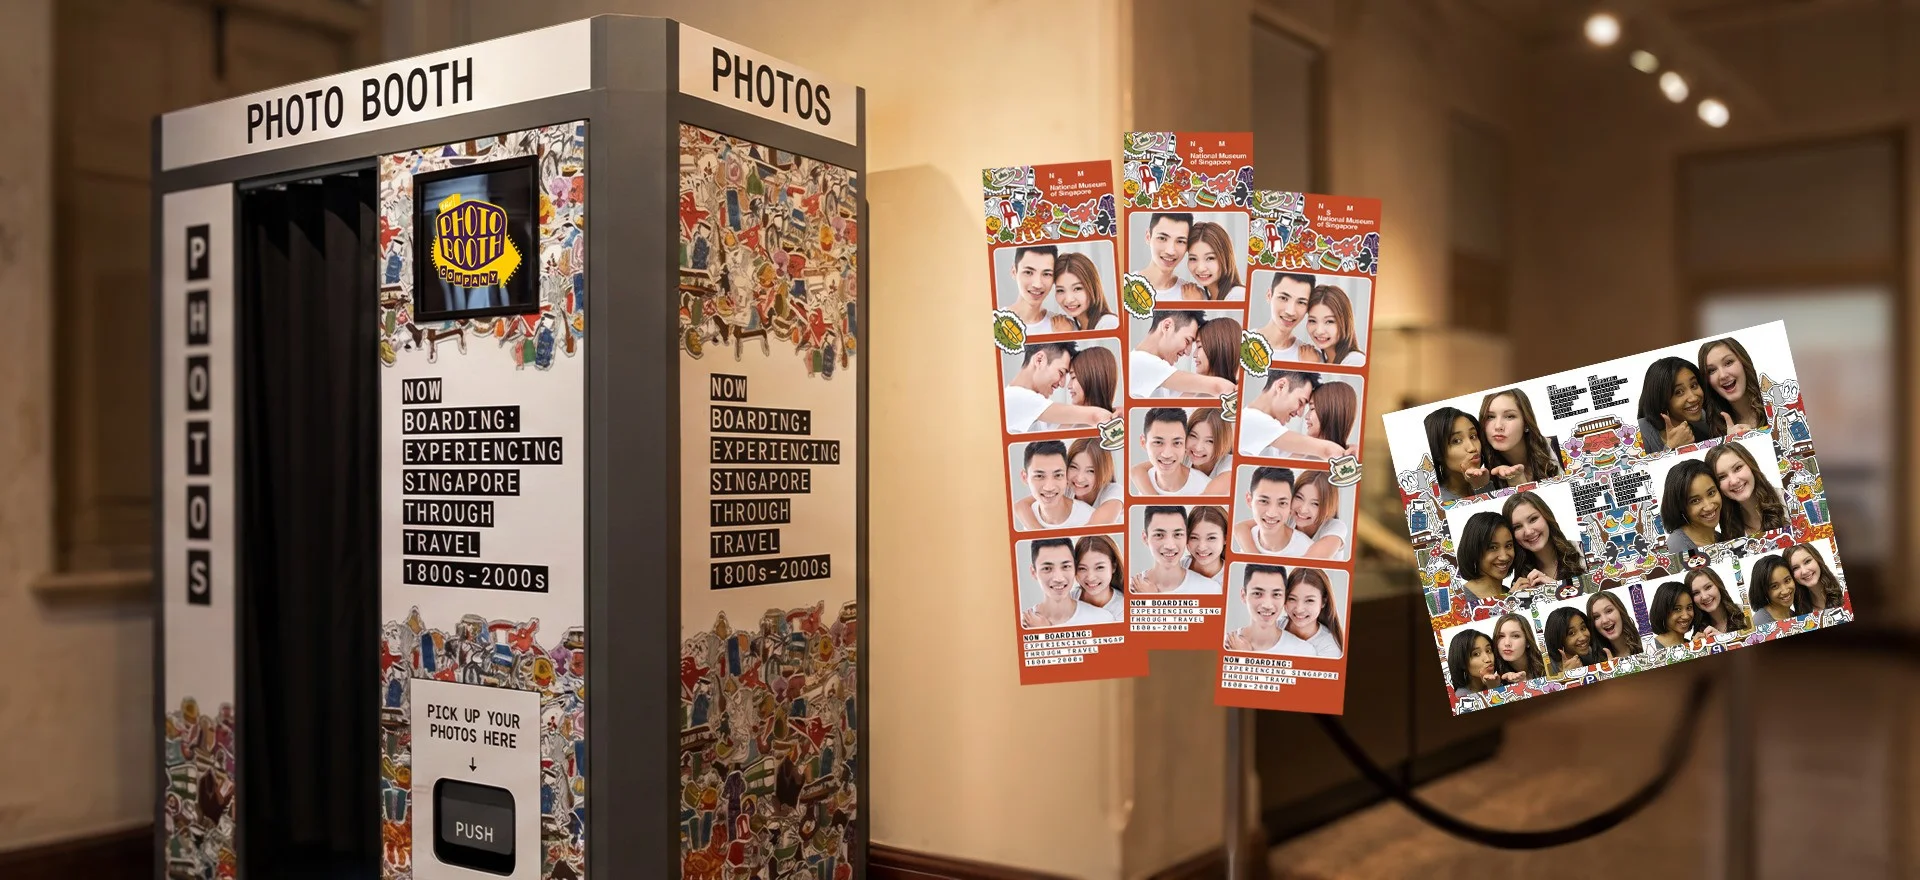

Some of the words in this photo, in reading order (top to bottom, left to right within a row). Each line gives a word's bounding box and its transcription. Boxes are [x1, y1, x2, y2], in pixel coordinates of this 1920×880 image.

[712, 46, 831, 126] PHOTOS
[247, 85, 344, 144] PHOTO
[362, 57, 473, 122] BOOTH
[1050, 183, 1077, 191] National
[1078, 181, 1107, 189] Museum
[1059, 189, 1092, 197] Singapore
[440, 205, 503, 237] PHOTO
[1318, 215, 1344, 223] National
[1346, 217, 1374, 225] Museum
[1325, 222, 1358, 230] Singapore
[442, 234, 501, 268] BOOTH
[440, 268, 497, 285] COMPANY
[404, 380, 441, 402] NOW
[712, 377, 746, 399] NOW
[188, 235, 208, 596] PHOTOS
[404, 409, 514, 432] BOARDING:
[712, 408, 807, 432] BOARDING:
[405, 440, 560, 462] EXPERIENCING
[712, 440, 838, 462] EXPERIENCING
[404, 472, 517, 493] SINGAPORE
[712, 471, 809, 491] SINGAPORE
[405, 502, 491, 524] THROUGH
[712, 501, 789, 523] THROUGH
[405, 532, 478, 554] TRAVEL
[712, 532, 777, 554] TRAVEL
[406, 563, 545, 589] 1800s-2000s
[713, 558, 828, 586] 1800s-2000s
[1024, 640, 1087, 649] EXPERIENCING
[1045, 631, 1091, 640] BOARDING:
[1224, 665, 1286, 675] EXPERIENCING
[1292, 670, 1337, 679] SINGAPORE
[1244, 658, 1291, 667] BOARDING:
[1223, 673, 1259, 681] THROUGH
[1266, 676, 1295, 684] TRAVEL
[427, 704, 458, 722] PICK
[465, 708, 480, 724] UP
[487, 710, 520, 729] YOUR
[430, 723, 477, 743] PHOTOS
[484, 730, 517, 749] HERE
[455, 821, 494, 843] PUSH
